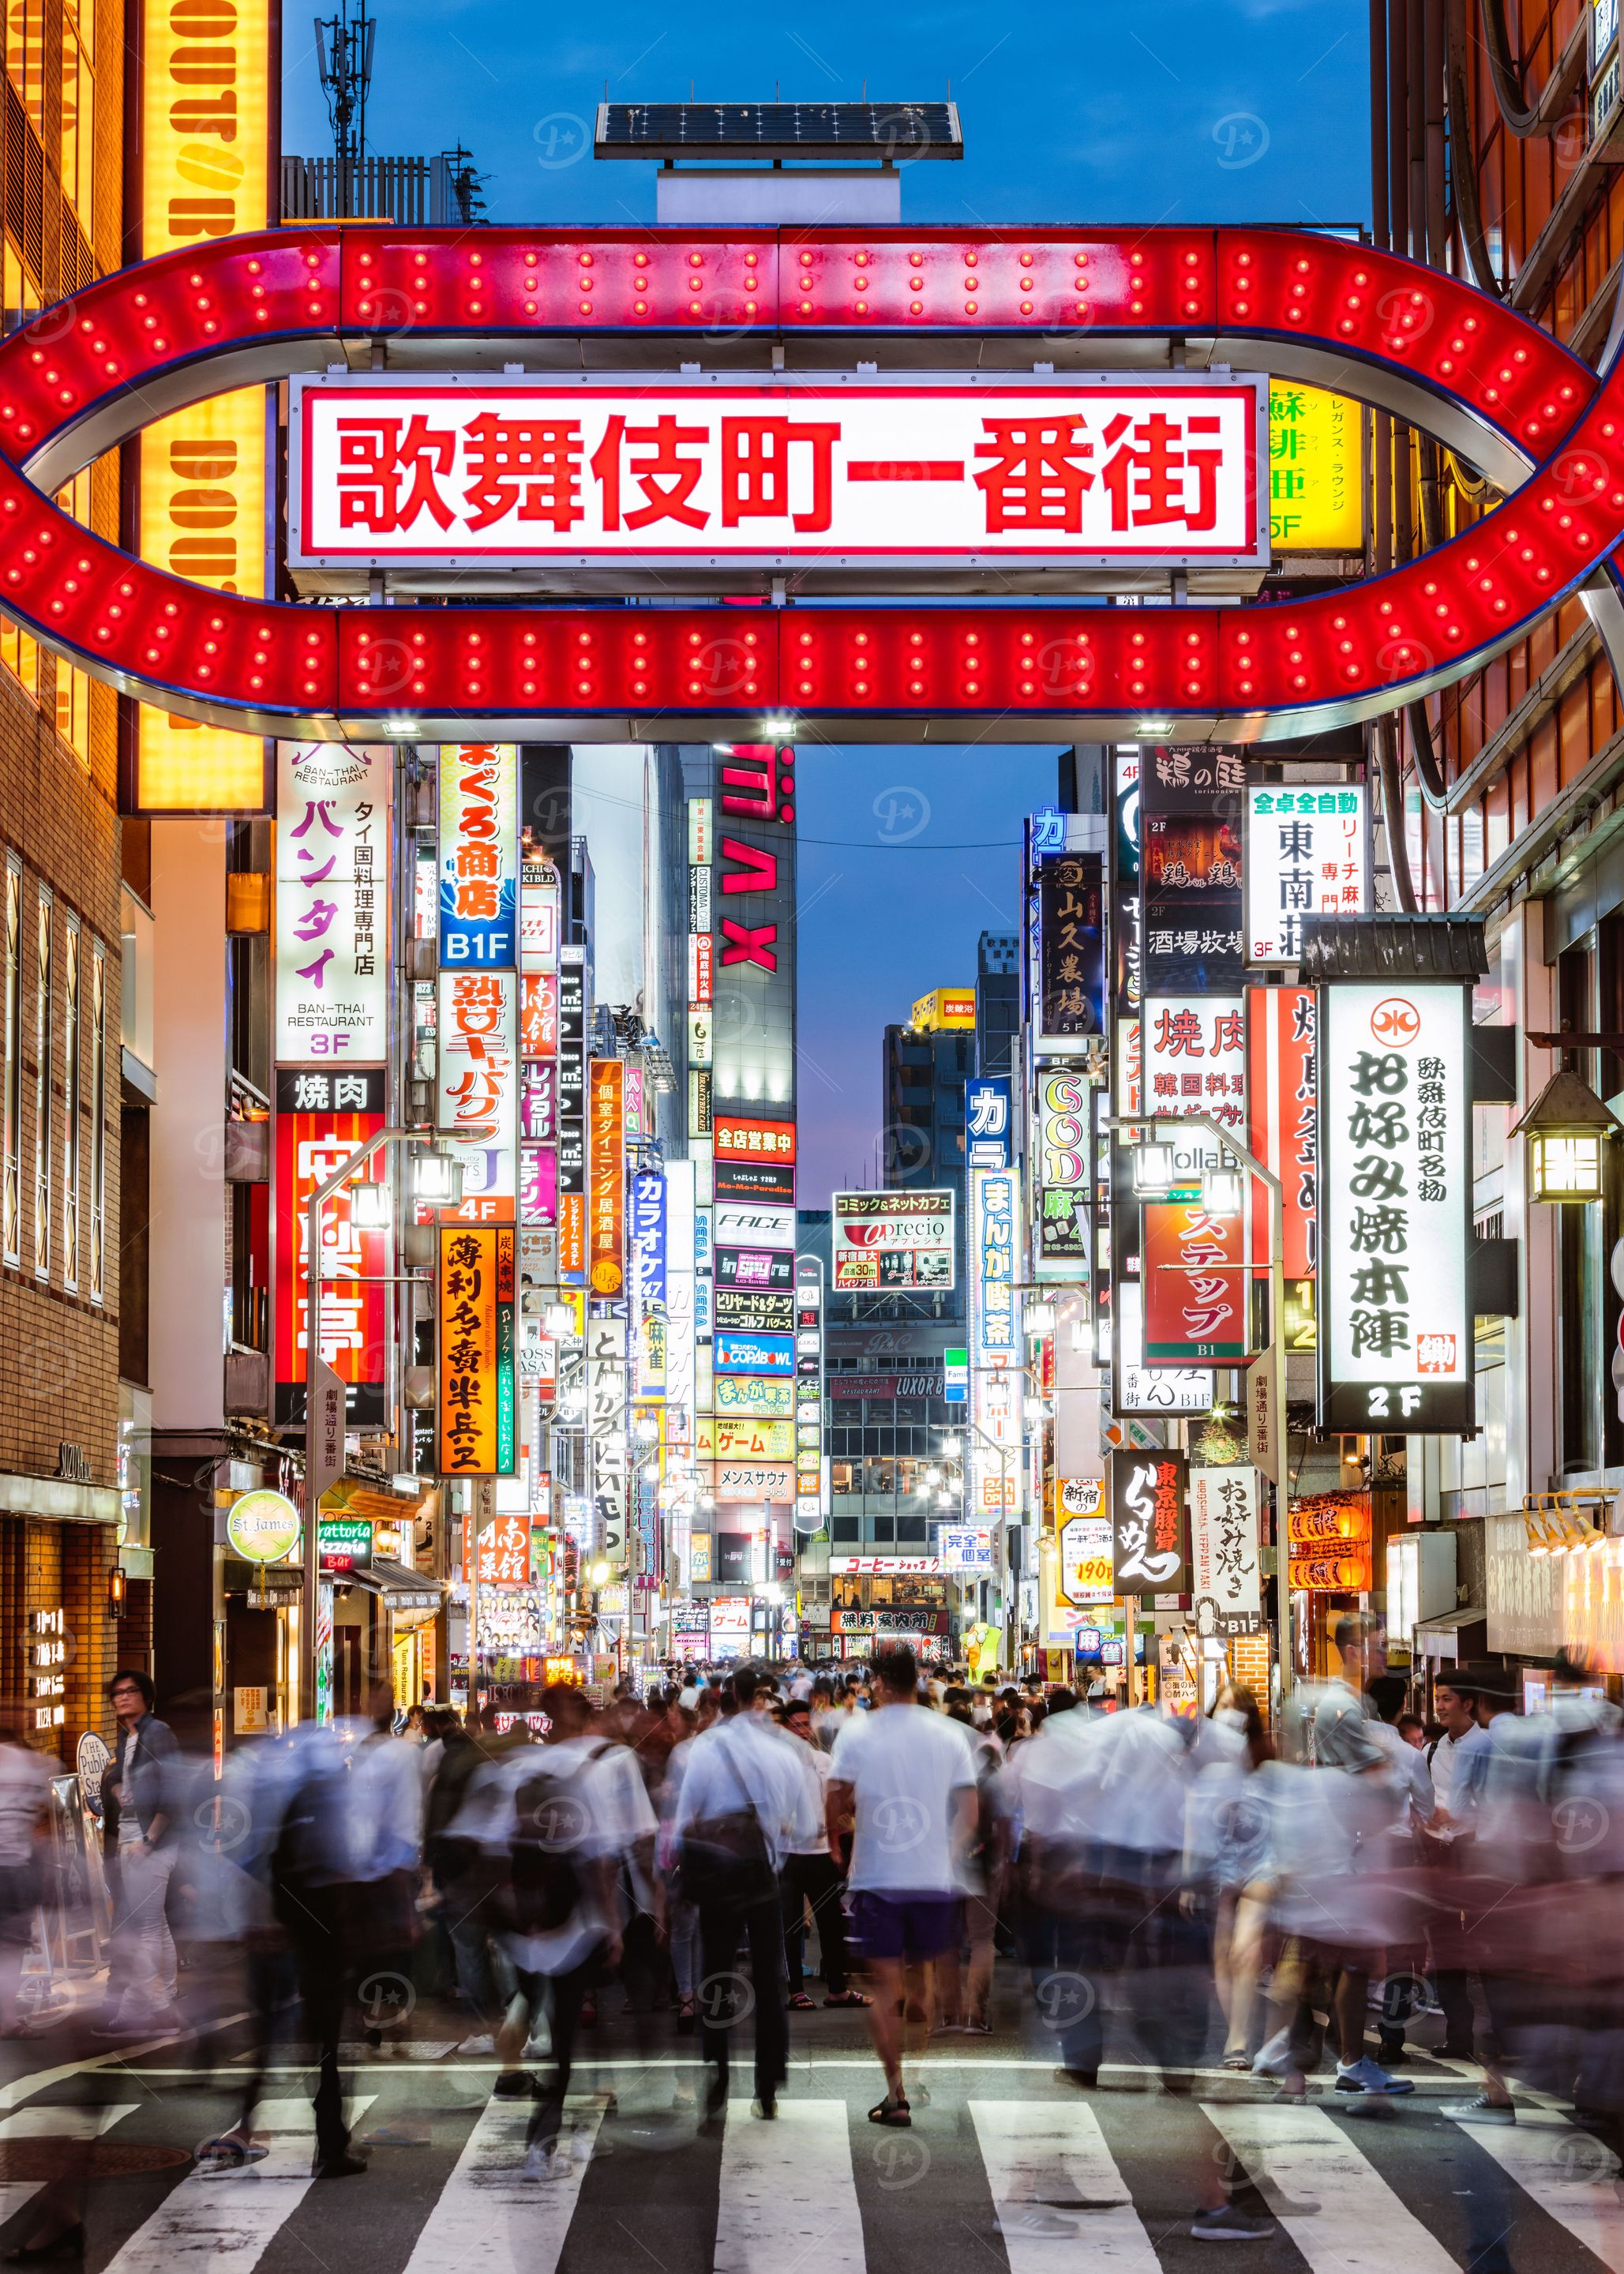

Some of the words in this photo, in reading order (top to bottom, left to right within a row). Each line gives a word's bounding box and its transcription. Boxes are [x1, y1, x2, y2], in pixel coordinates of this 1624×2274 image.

[1331, 393, 1345, 512] レガンス・ラウンジ
[336, 411, 1222, 535] 歌舞伎町一番街
[294, 769, 370, 787] RESTAURANT
[303, 763, 361, 778] BAN-THAI
[1155, 751, 1247, 789] 鶏の庭
[1253, 792, 1359, 815] 全卓全自動
[1151, 822, 1166, 832] 2F
[1341, 819, 1359, 914] リーチ麻
[289, 799, 345, 990] バンタイ
[353, 801, 375, 976] タイ国料理専門店
[698, 868, 708, 909] CUSTOMA
[1278, 820, 1314, 957] 東南荘
[1321, 861, 1339, 914] 専門
[1151, 906, 1165, 916] 2F
[446, 932, 508, 960] B1F
[1056, 891, 1086, 1017] 山久農場
[1149, 929, 1243, 955] 酒場牧場
[1254, 942, 1273, 957] 3F
[287, 1015, 374, 1027] RESTAURANT
[297, 1003, 366, 1015] BAN-THAI
[945, 1004, 973, 1014] 炭酸浴
[1062, 1022, 1083, 1033] 5F
[1153, 1008, 1243, 1058] 焼肉
[310, 1033, 351, 1055] 3F
[294, 1075, 369, 1110] 焼肉
[531, 1064, 551, 1138] レンタル
[717, 1127, 791, 1154] 全店営業中
[1045, 1075, 1085, 1185] GOD
[1416, 1056, 1447, 1203] 歌舞伎町名物
[598, 1083, 614, 1250] 個室ダイニング居酒屋
[717, 1181, 793, 1195] Mo-Mo-Paradiso
[458, 1198, 497, 1221] 4F
[838, 1196, 950, 1212] コミック&ネットカフェ
[1042, 1188, 1090, 1219] 麻
[1348, 1050, 1412, 1360] お好み焼本陣
[637, 1176, 663, 1279] カラオケ
[718, 1214, 793, 1230] FACE
[696, 1214, 707, 1259] SEGA
[498, 1235, 514, 1295] 炭火串焼
[838, 1251, 878, 1262] 新宿最大
[983, 1180, 1013, 1345] まんが喫茶
[838, 1278, 878, 1288] ハイジアB1
[843, 1264, 876, 1276] 直進30m
[1179, 1207, 1233, 1339] ステップ
[696, 1284, 707, 1327] SEGA
[716, 1292, 793, 1314] ビリヤード&ダーツ
[647, 1320, 665, 1371] 麻雀
[1196, 1343, 1217, 1357] B1
[718, 1379, 791, 1406] まんが喫茶
[896, 1376, 934, 1397] LUXOR
[1125, 1364, 1141, 1407] 一番街
[1180, 1393, 1210, 1407] B1F
[1367, 1387, 1422, 1417] 2F
[1255, 1374, 1270, 1454] 劇場通り一番街
[324, 1388, 337, 1469] 劇場通り一番街
[718, 1432, 766, 1453] ゲーム
[721, 1470, 788, 1486] メンズサウナ
[1064, 1485, 1098, 1504] 新宿
[1153, 1461, 1179, 1552] 東京豚骨
[1075, 1503, 1088, 1513] の
[318, 1522, 371, 1539] rattoria
[947, 1534, 977, 1548] 完全
[1213, 1477, 1255, 1599] お好み焼き
[326, 1555, 351, 1568] Bar
[961, 1548, 991, 1563] 個室
[714, 1615, 748, 1627] ゲーム
[840, 1612, 928, 1629] 無料案内所
[1227, 1619, 1259, 1633] B1F
[1078, 1628, 1123, 1665] 麻雀
[84, 1740, 100, 1754] THE
[85, 1777, 101, 1796] Sta
